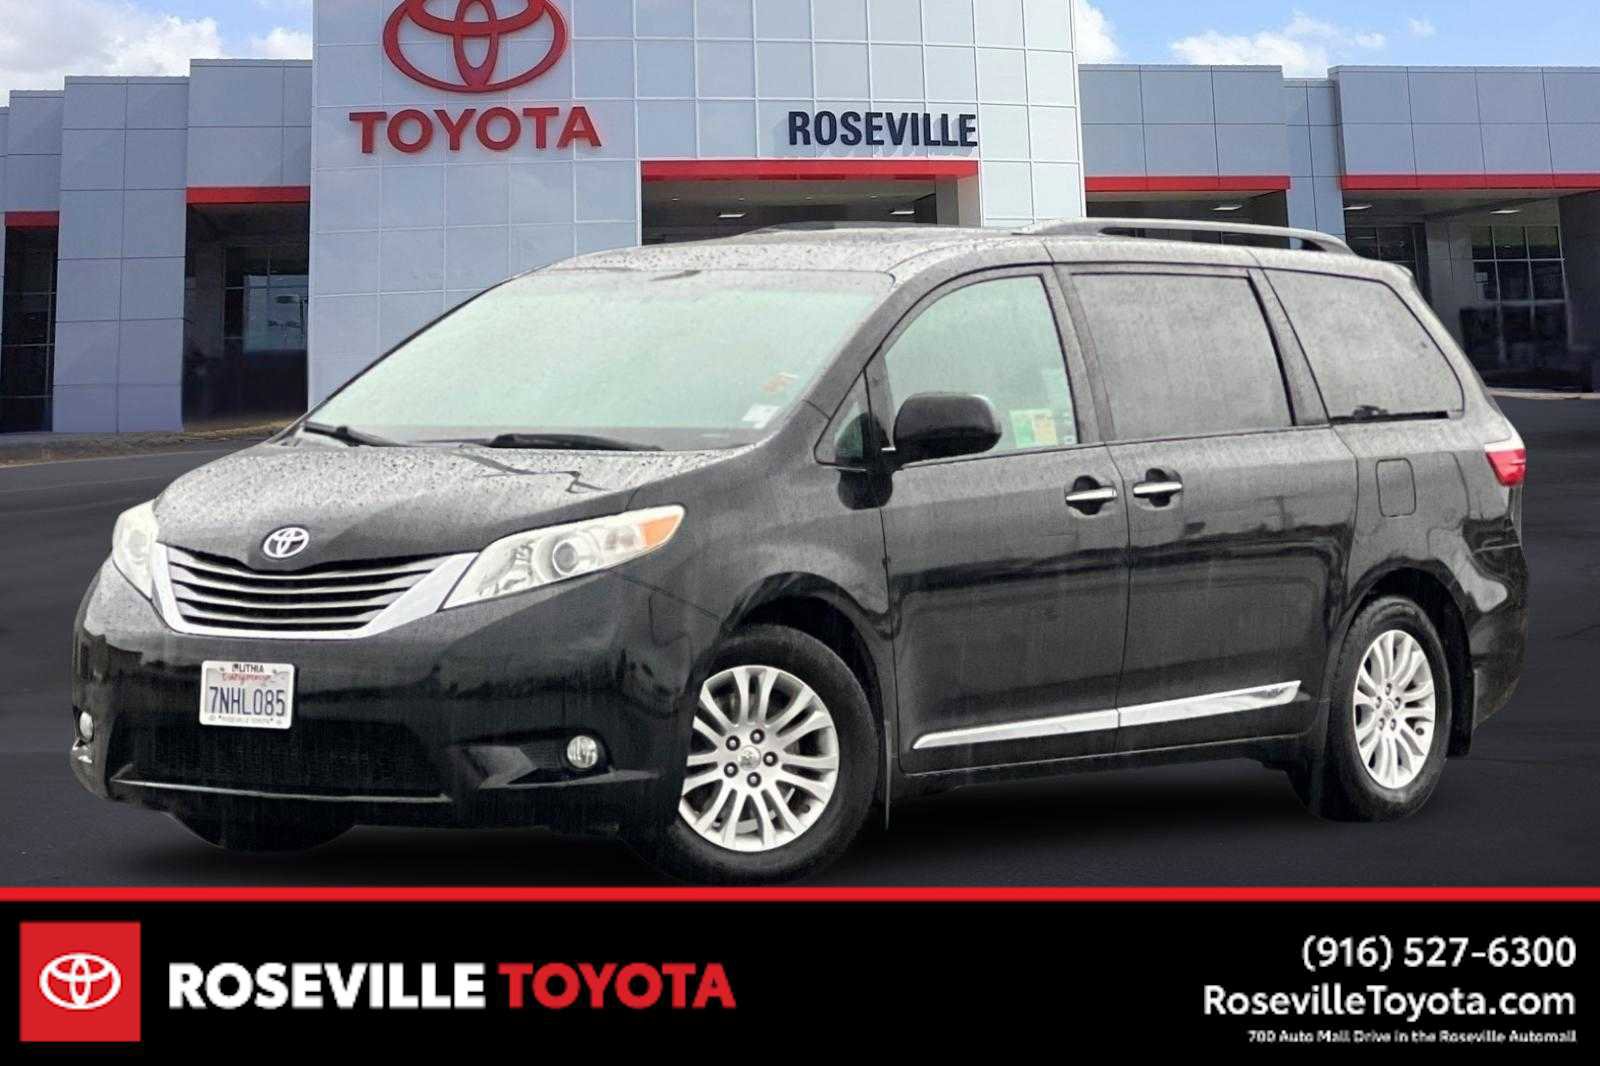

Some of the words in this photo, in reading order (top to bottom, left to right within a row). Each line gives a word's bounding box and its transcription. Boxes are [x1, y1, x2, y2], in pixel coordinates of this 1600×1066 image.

[350, 105, 601, 153] TOYOTA
[788, 111, 979, 147] ROSEVILLE
[209, 686, 286, 717] 7NHL085
